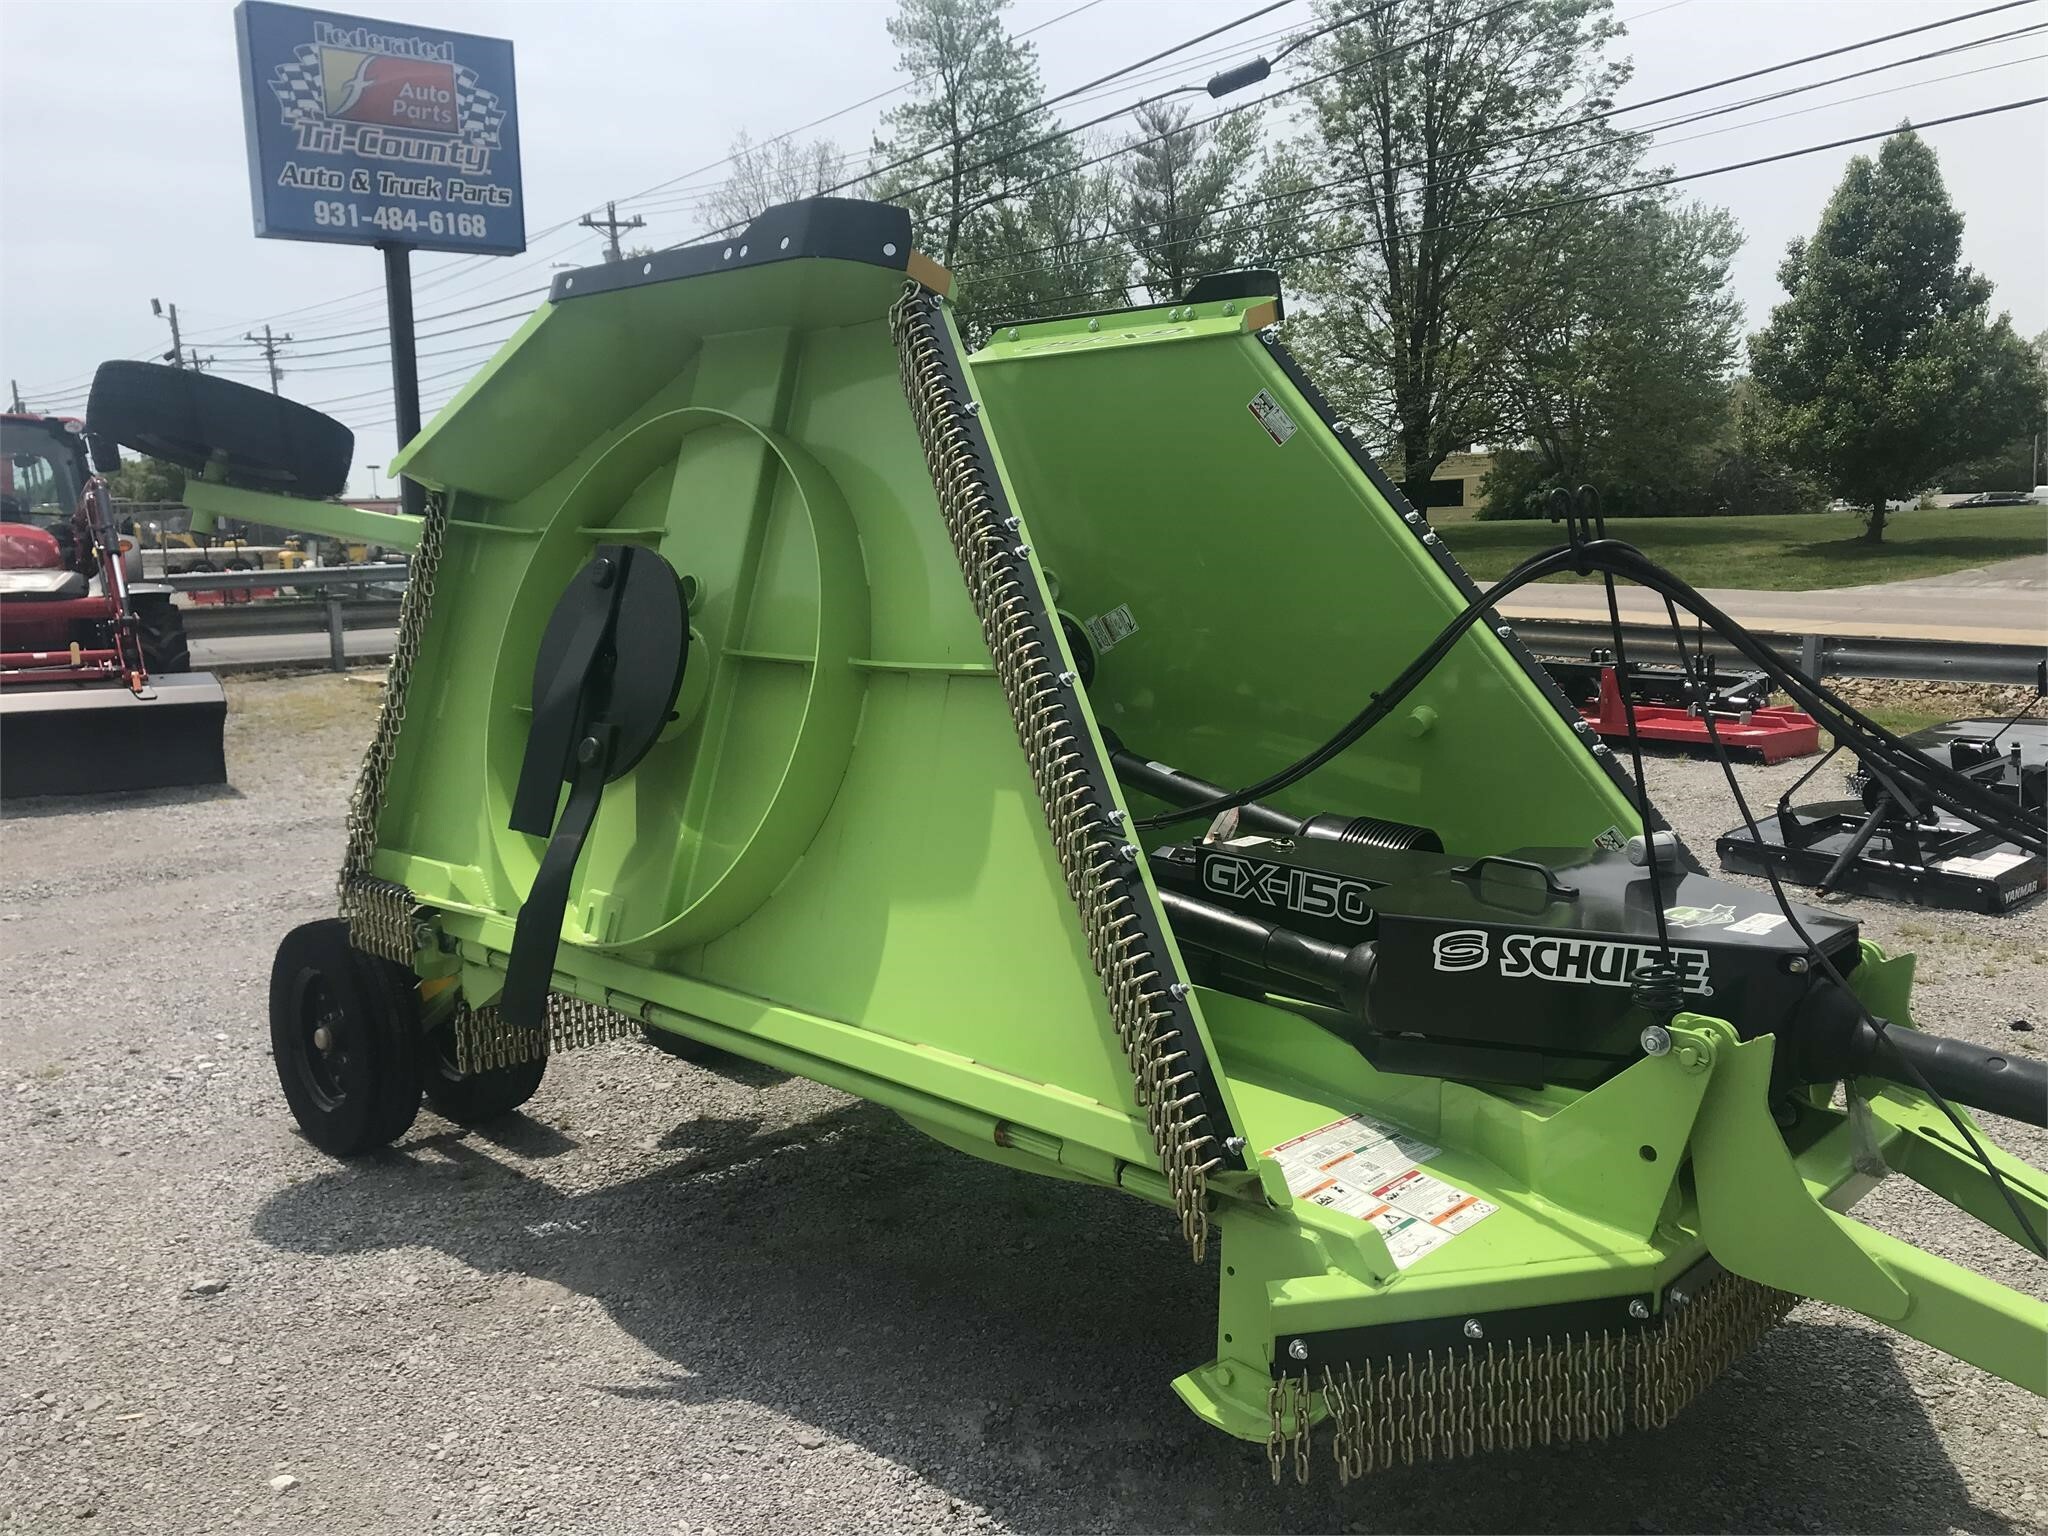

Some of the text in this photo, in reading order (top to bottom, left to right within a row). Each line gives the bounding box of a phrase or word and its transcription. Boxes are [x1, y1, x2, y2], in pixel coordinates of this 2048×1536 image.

[313, 20, 455, 63] Federated
[392, 99, 452, 124] Parts
[399, 81, 451, 104] Auto
[295, 121, 489, 175] Tri-County
[278, 161, 512, 207] Auto & Truck Parts
[313, 200, 487, 238] 931-484-6168
[1203, 853, 1375, 926] GX-150
